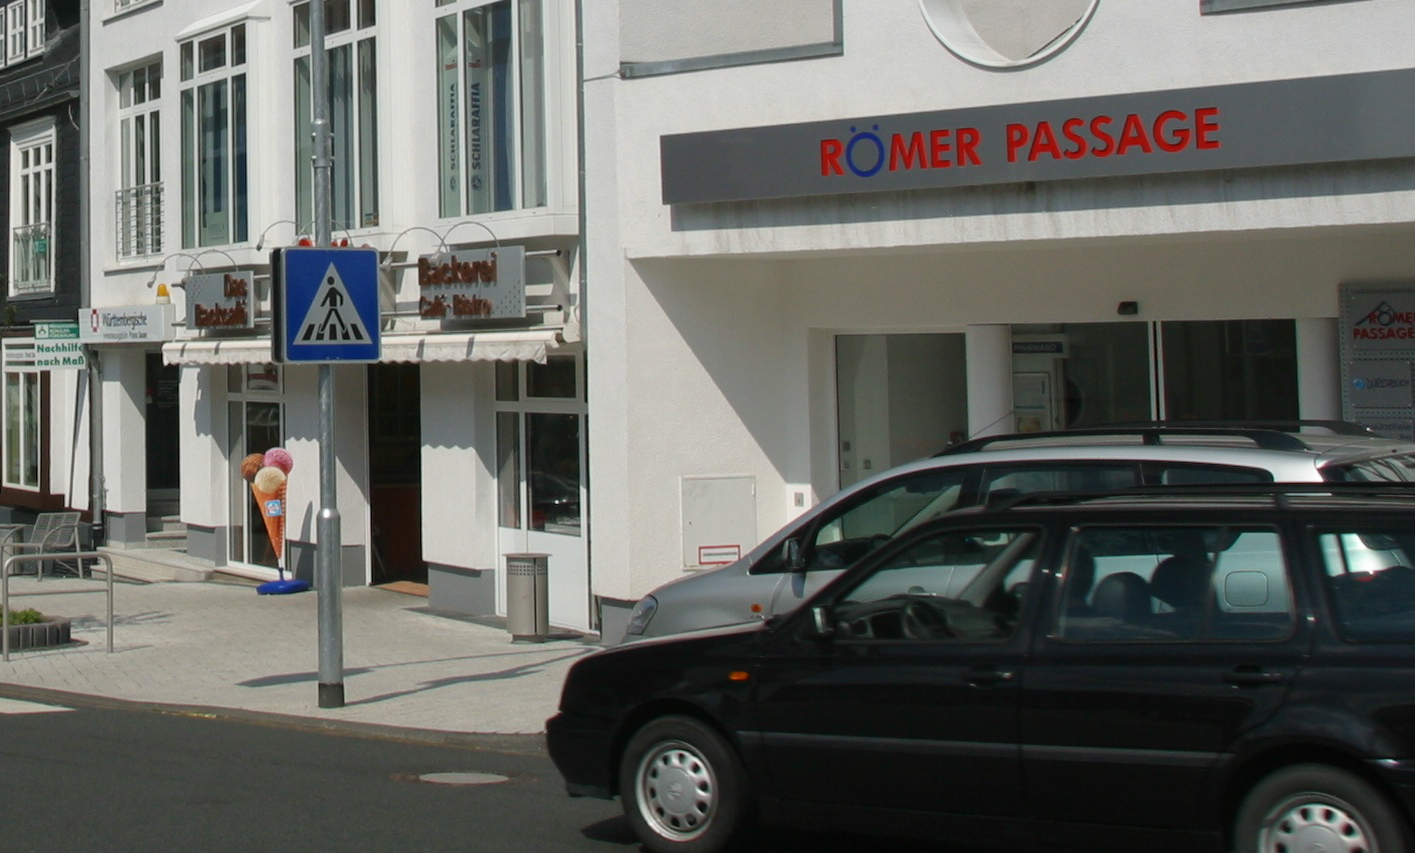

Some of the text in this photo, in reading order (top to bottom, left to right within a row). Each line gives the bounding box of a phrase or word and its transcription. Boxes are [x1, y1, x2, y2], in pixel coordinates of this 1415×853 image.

[471, 82, 481, 170] SCHLARAFFIA
[820, 106, 1222, 178] RÖMER PASSAGE
[1369, 309, 1415, 326] RÖME
[1353, 327, 1415, 339] PASSAGE
[37, 355, 84, 366] nach Maß
